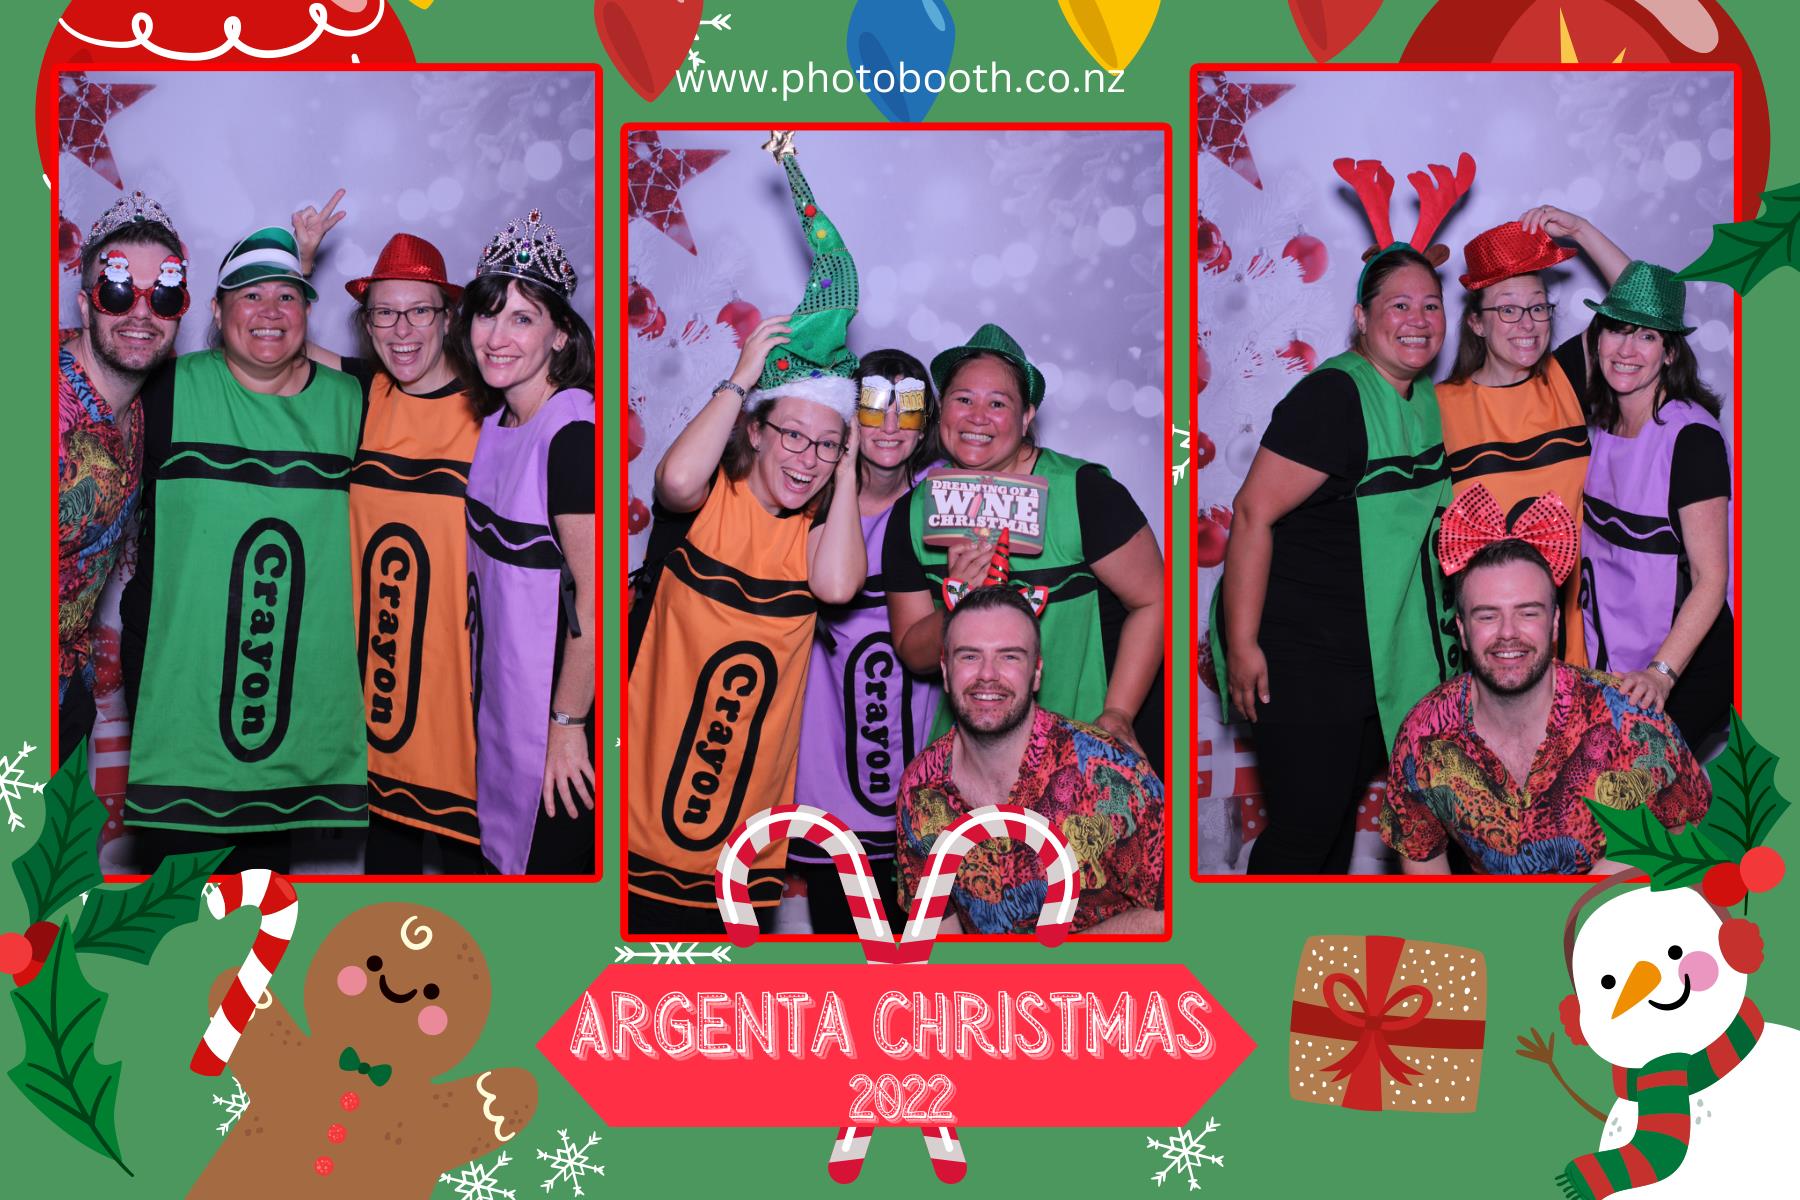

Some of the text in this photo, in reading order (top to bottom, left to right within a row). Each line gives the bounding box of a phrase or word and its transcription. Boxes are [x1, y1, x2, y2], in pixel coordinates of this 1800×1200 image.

[928, 514, 1040, 537] CHRISTMAS
[931, 480, 1040, 498] DREAMING OF A
[240, 543, 288, 736] Crayon
[370, 546, 411, 724] Crayon
[682, 663, 758, 825] Crayon
[860, 650, 894, 794] Crayon
